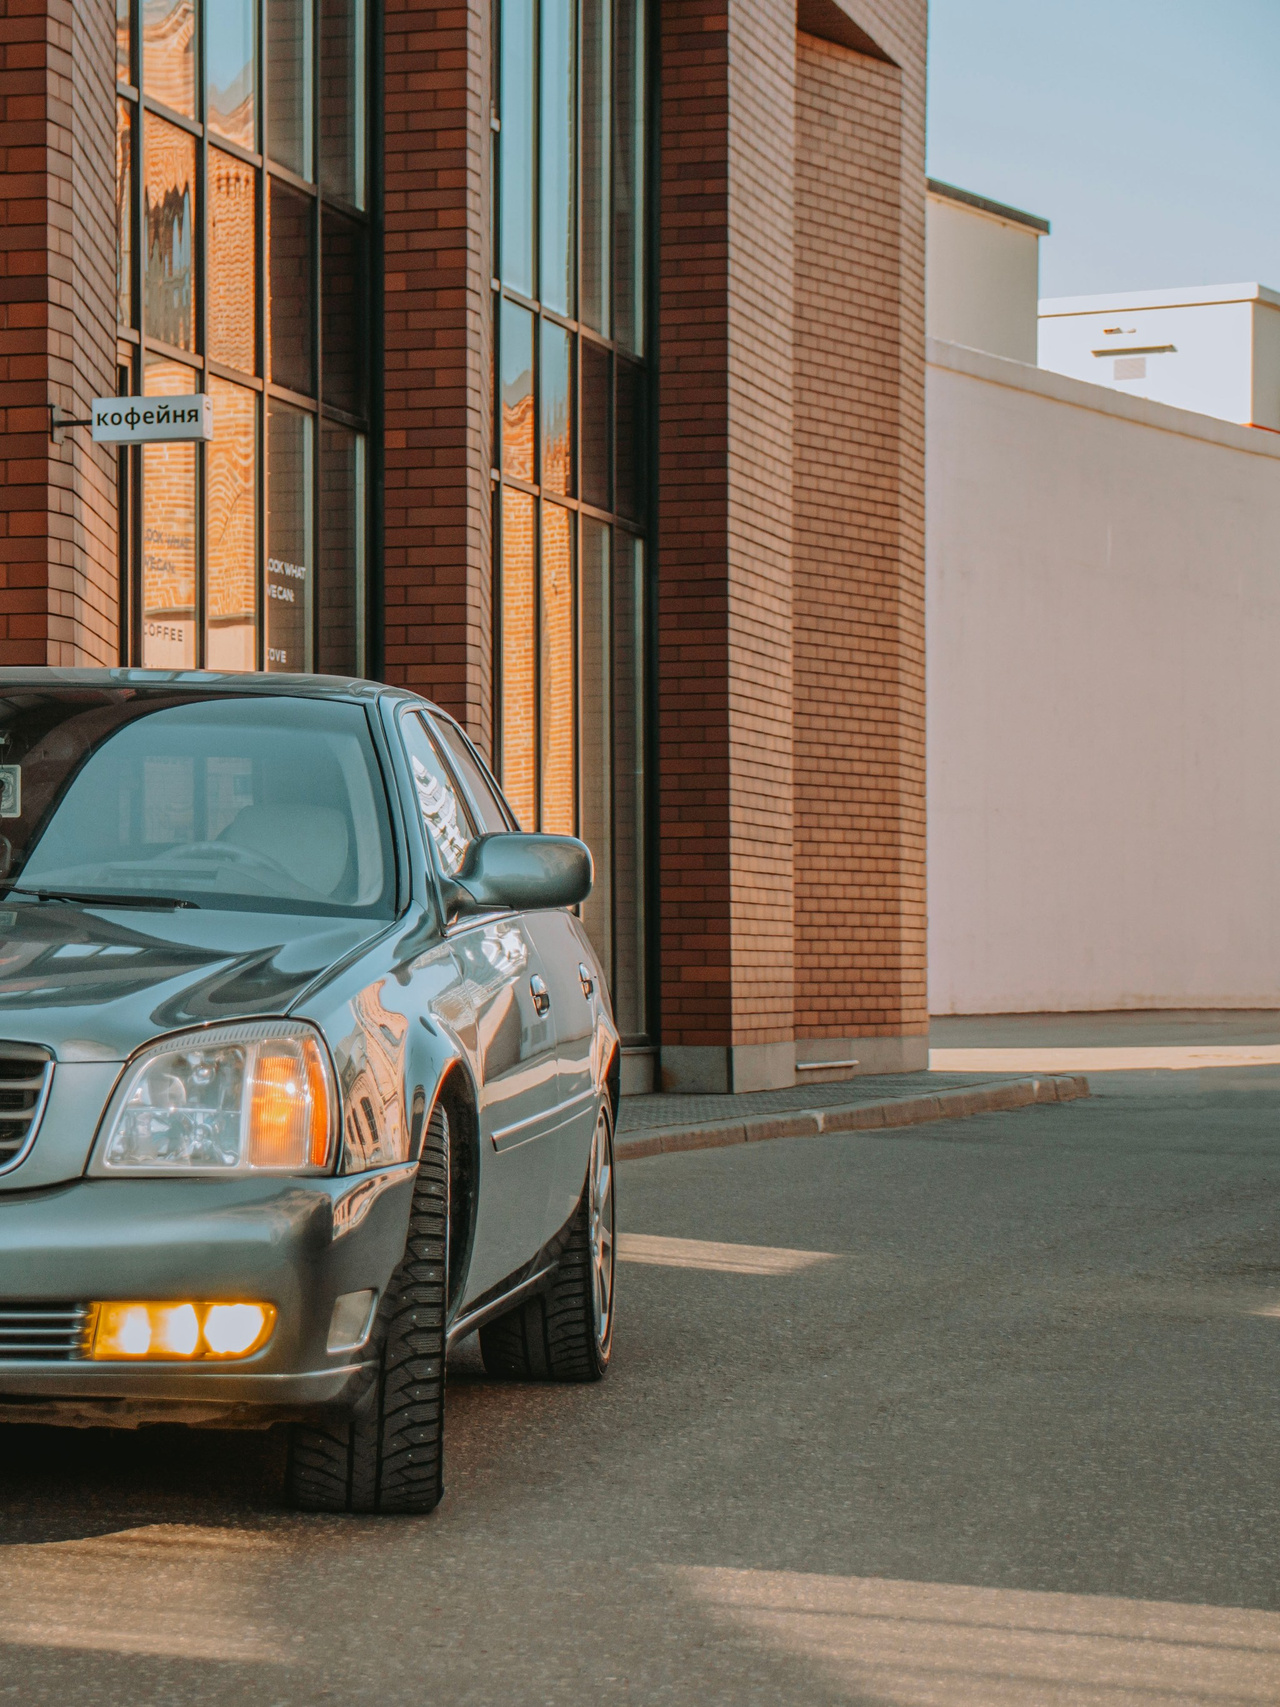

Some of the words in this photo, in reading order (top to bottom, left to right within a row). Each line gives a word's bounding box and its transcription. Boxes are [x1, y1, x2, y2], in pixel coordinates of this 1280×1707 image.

[96, 404, 199, 431] кофейня
[144, 528, 163, 544] OOK
[267, 557, 284, 575] OOK
[267, 647, 287, 664] OVE
